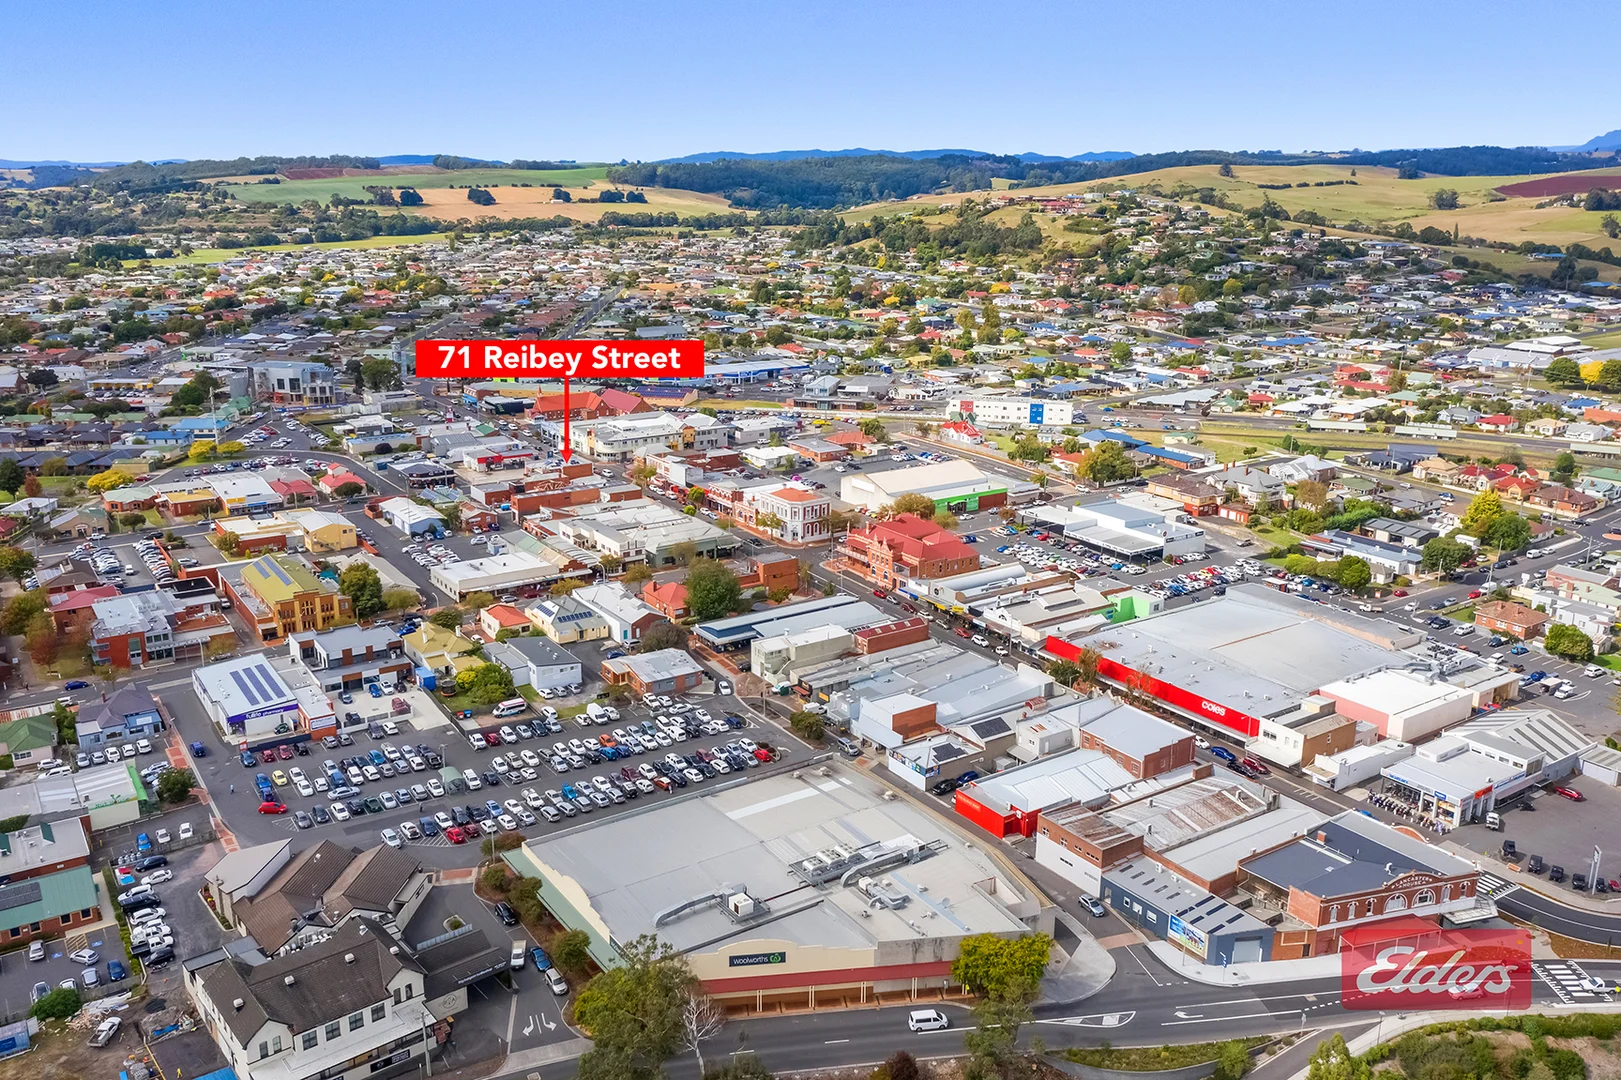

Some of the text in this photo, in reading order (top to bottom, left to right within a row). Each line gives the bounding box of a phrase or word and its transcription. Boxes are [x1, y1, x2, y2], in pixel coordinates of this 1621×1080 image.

[1201, 701, 1226, 716] coles
[1395, 875, 1430, 887] LANCASTER
[733, 956, 769, 965] woolworths
